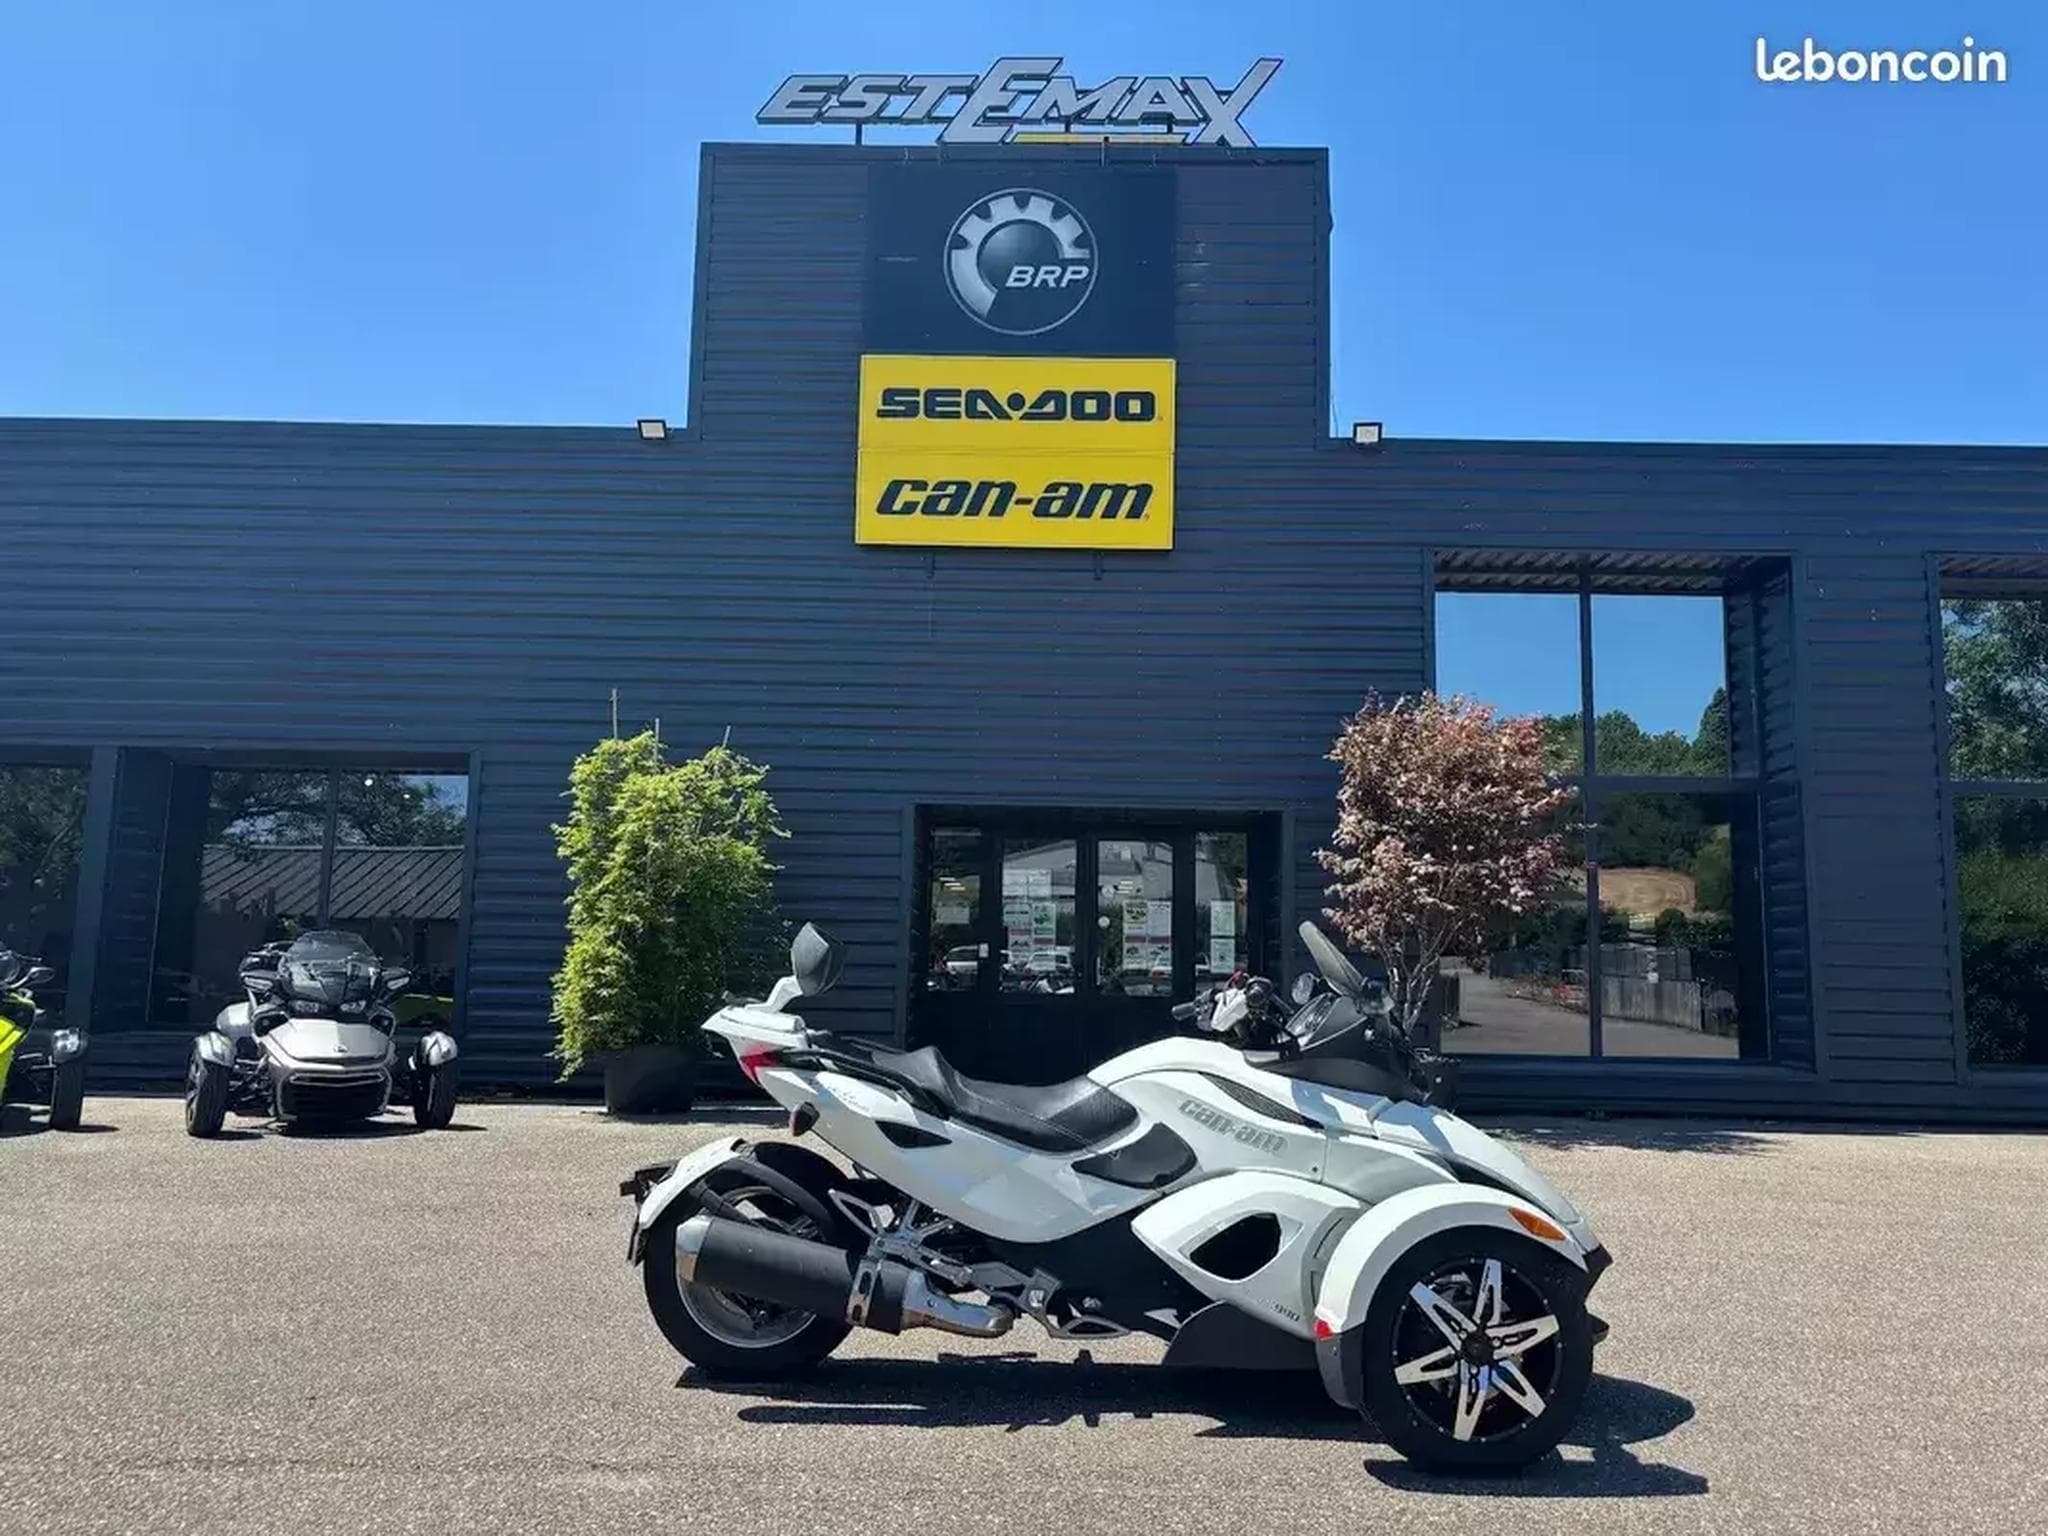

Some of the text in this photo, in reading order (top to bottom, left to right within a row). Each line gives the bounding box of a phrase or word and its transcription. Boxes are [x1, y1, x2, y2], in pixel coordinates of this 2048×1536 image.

[756, 57, 1284, 147] ESTEMAX
[1005, 265, 1090, 288] BRP
[876, 479, 1154, 519] can-am
